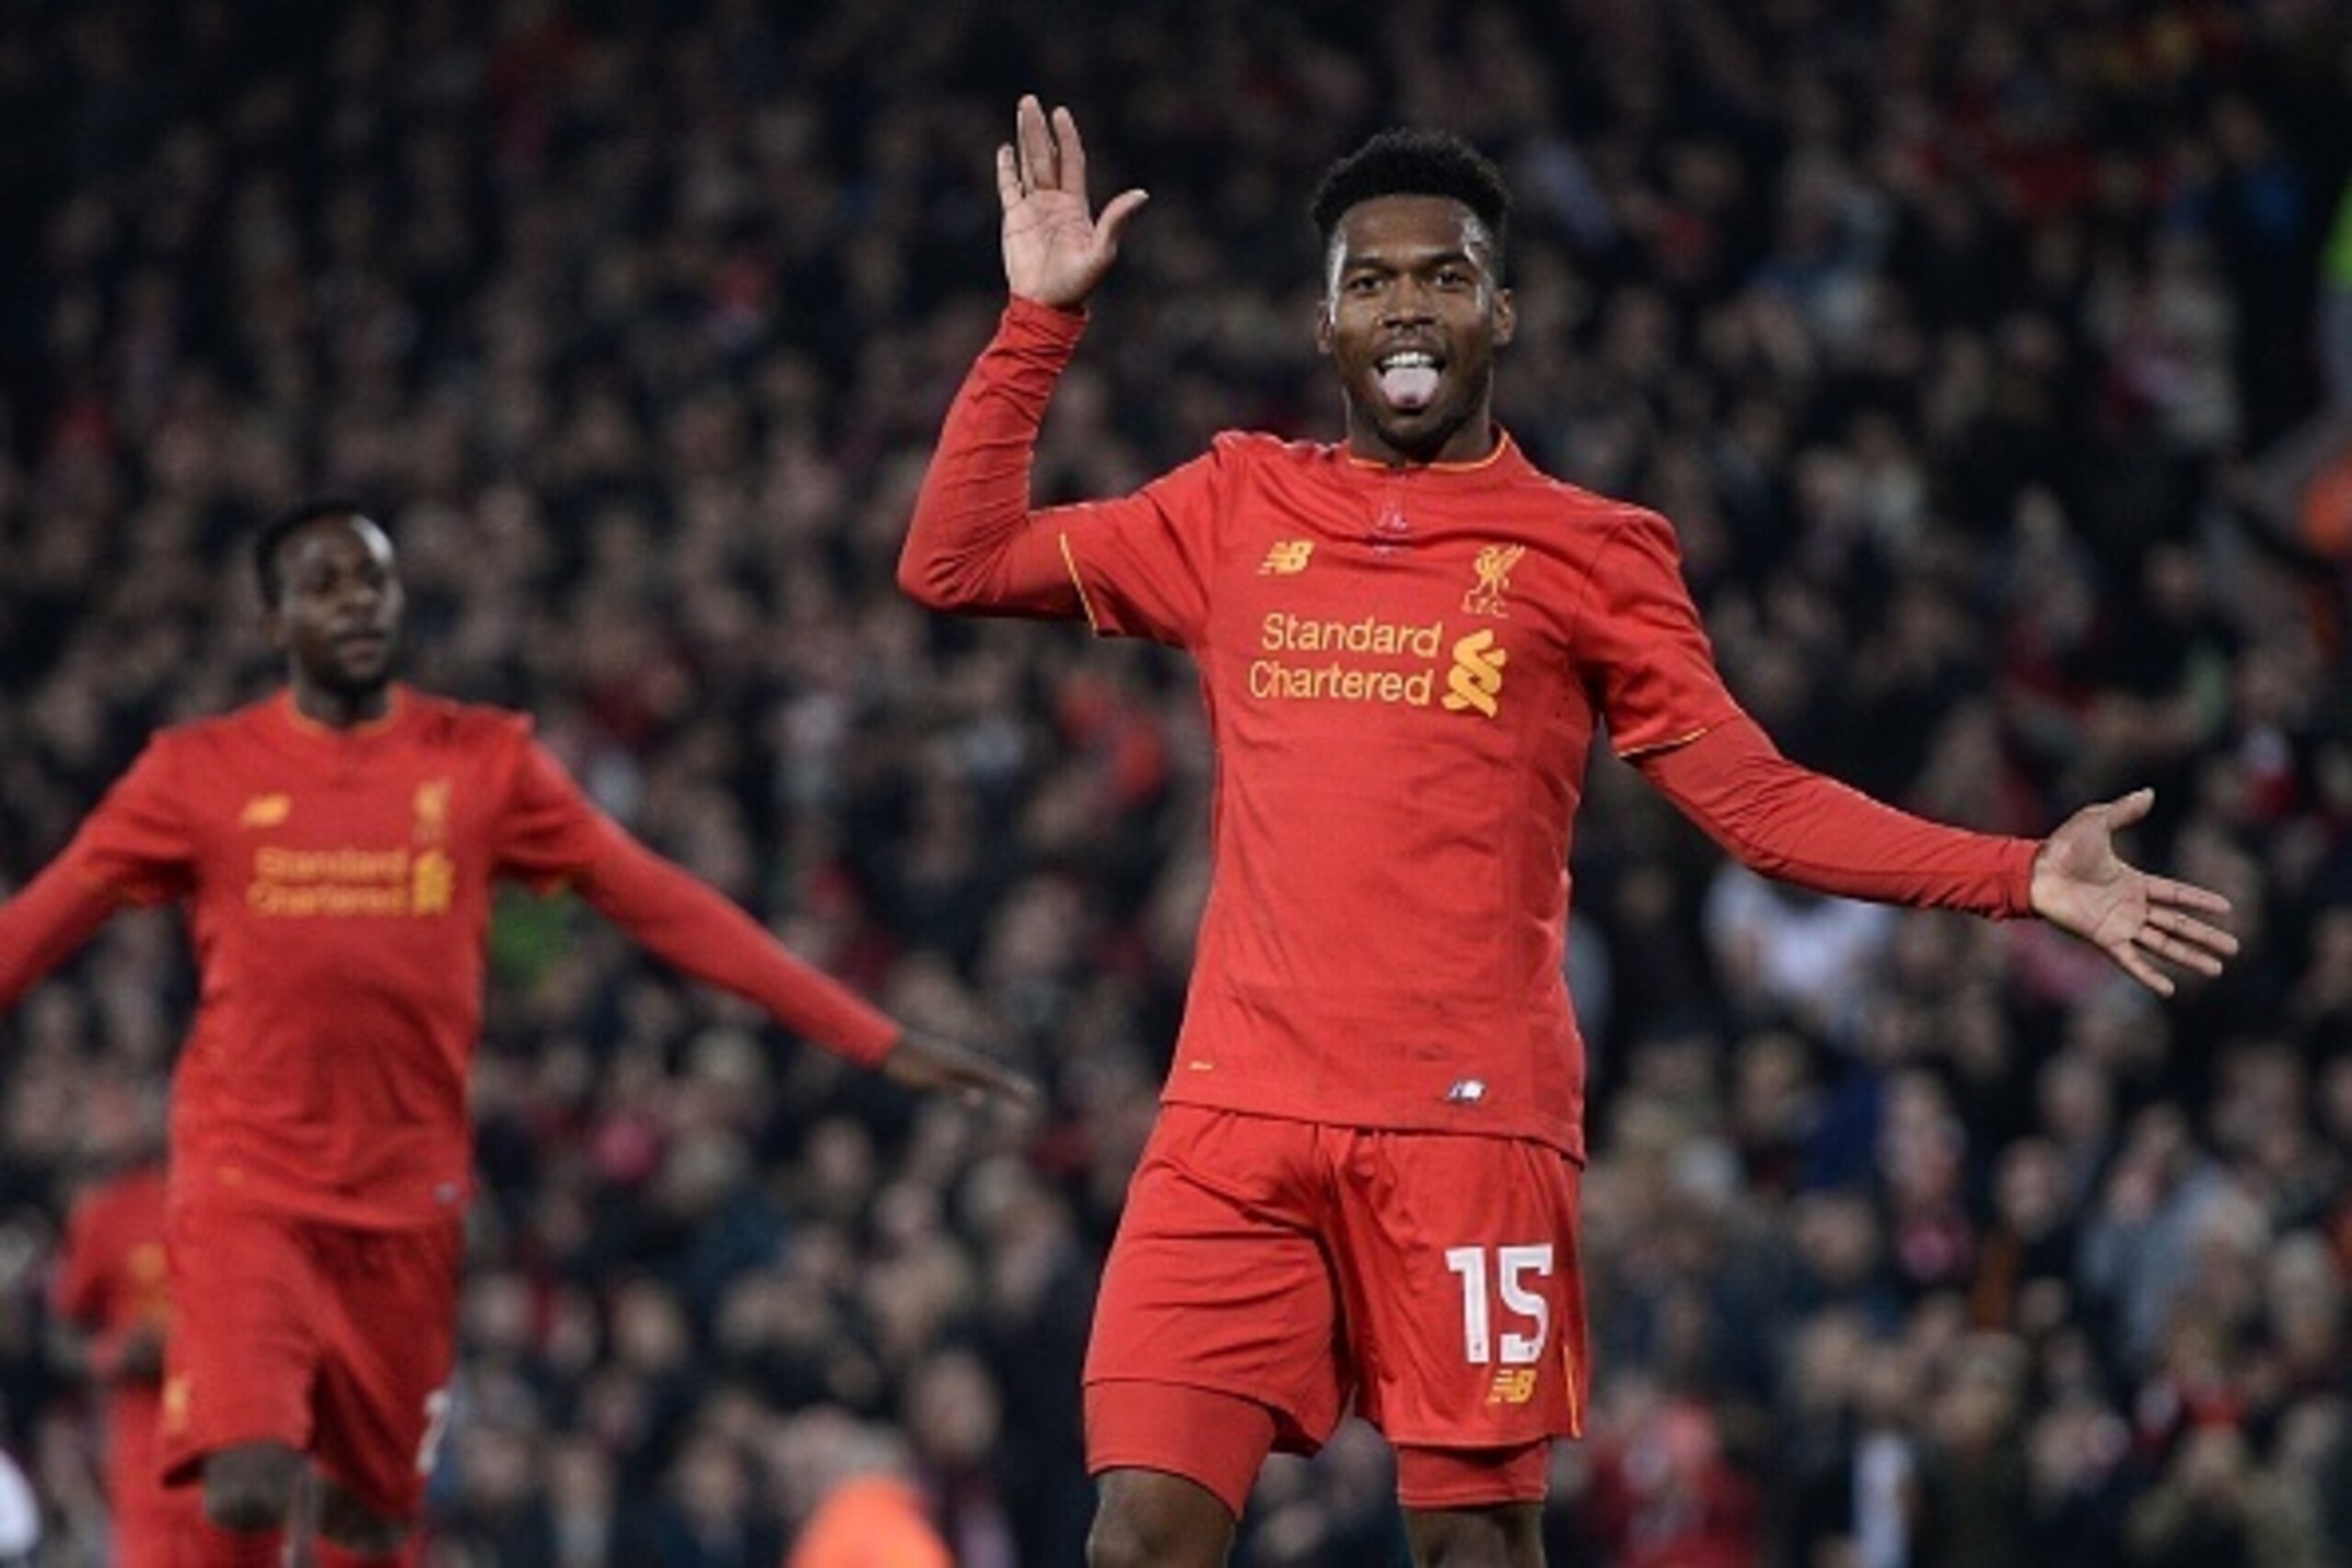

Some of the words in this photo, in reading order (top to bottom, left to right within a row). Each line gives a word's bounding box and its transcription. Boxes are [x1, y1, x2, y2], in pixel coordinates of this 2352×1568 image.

[1261, 612, 1442, 659] Standard
[1250, 660, 1434, 706] Chartered
[1444, 1243, 1553, 1364] 15
